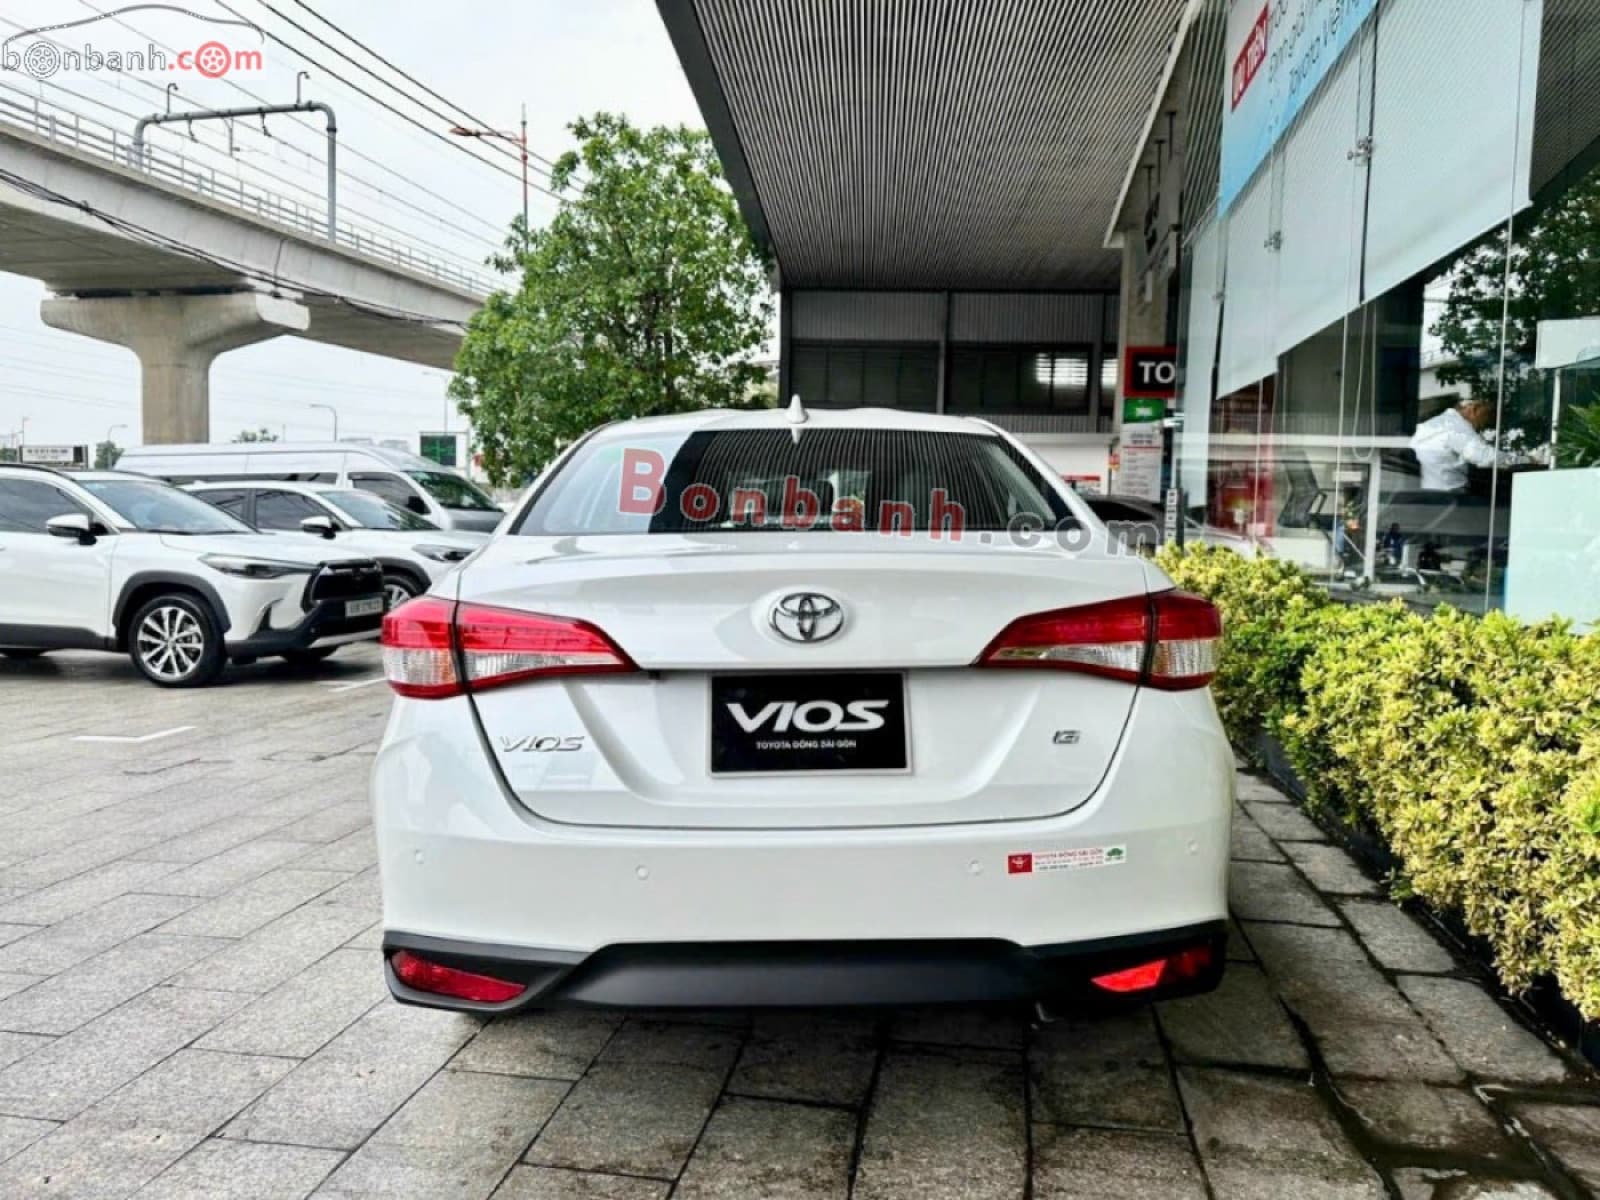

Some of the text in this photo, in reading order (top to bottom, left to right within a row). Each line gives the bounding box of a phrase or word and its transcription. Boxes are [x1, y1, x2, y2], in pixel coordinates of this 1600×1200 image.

[726, 700, 889, 733] VIOS
[500, 736, 584, 752] VIOS
[756, 740, 791, 750] TOYOTA
